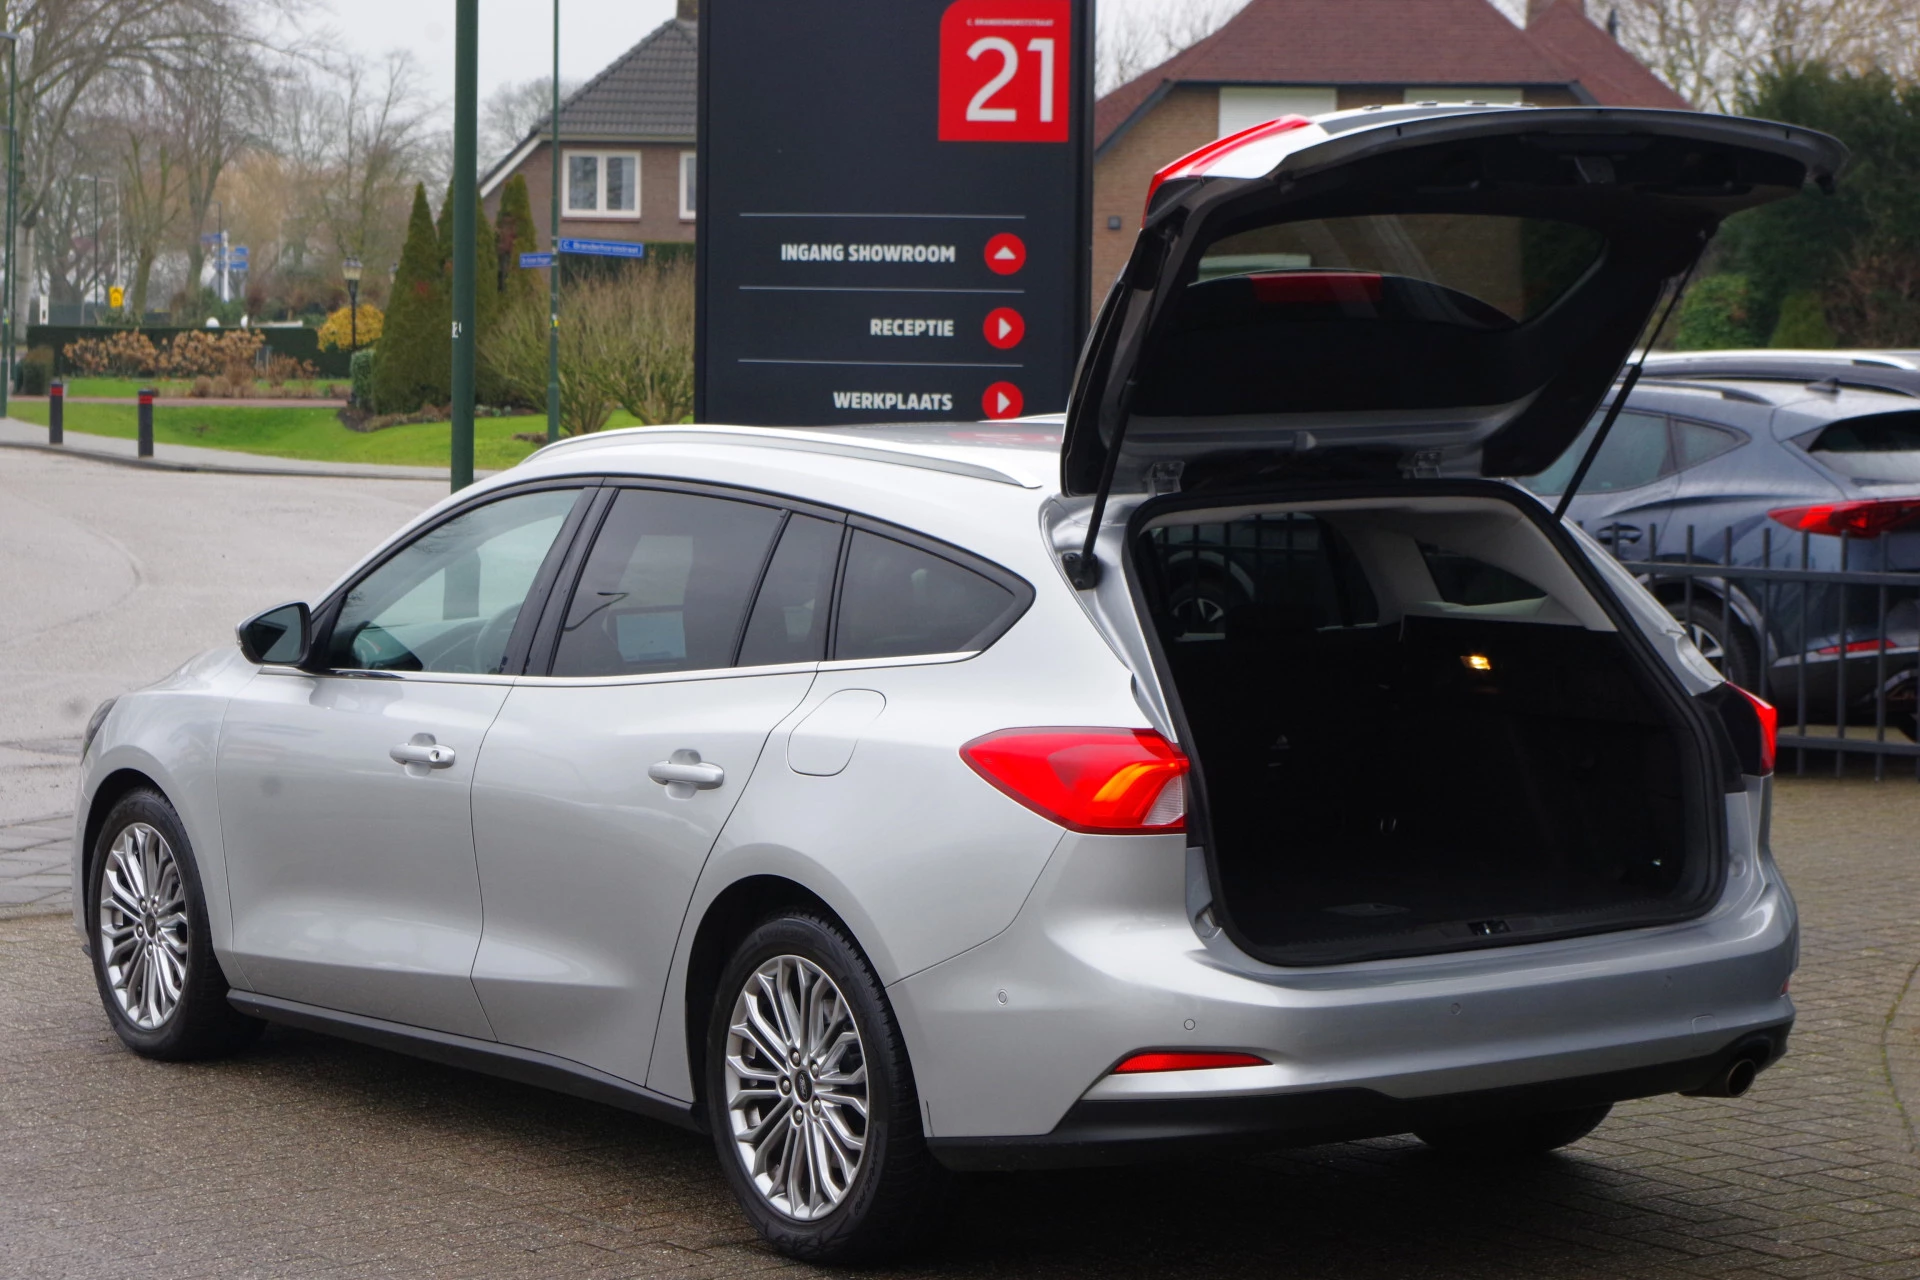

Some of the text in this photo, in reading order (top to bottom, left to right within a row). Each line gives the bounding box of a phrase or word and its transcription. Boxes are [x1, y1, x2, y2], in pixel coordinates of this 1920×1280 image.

[966, 36, 1054, 122] 21
[781, 244, 956, 263] INGANG SHOWROOM
[870, 318, 954, 337] RECEPTIE
[833, 391, 953, 411] WERKPLAATS
